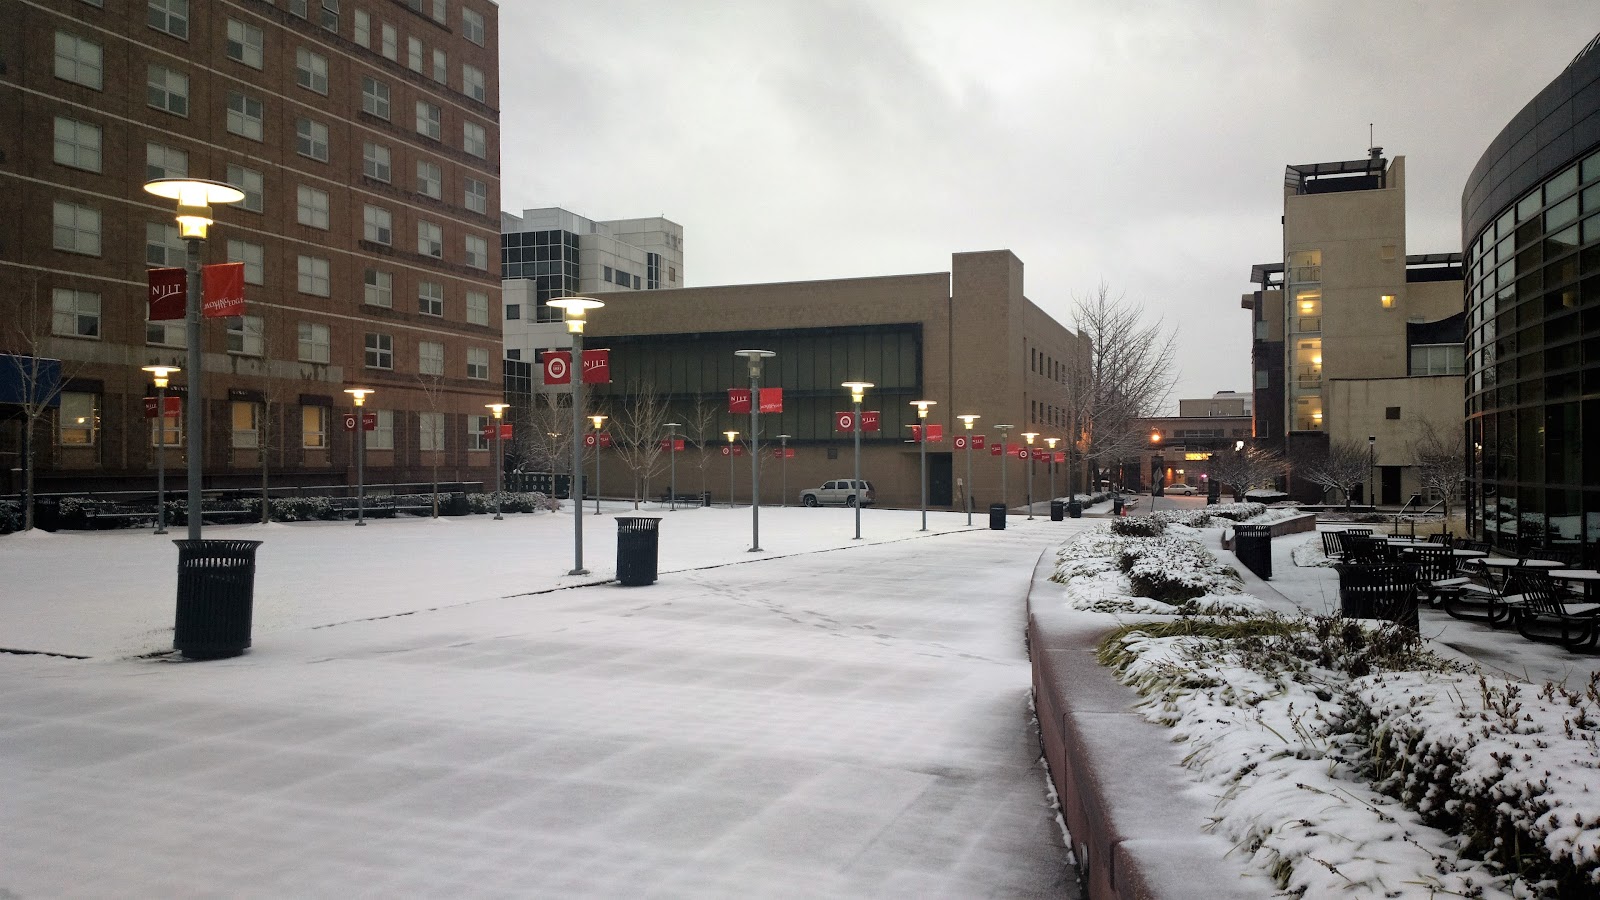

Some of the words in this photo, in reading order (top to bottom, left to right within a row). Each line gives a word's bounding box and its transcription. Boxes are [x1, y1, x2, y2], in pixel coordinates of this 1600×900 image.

[152, 284, 181, 296] NJIT
[228, 297, 244, 307] EDGE
[583, 359, 606, 368] NJIT
